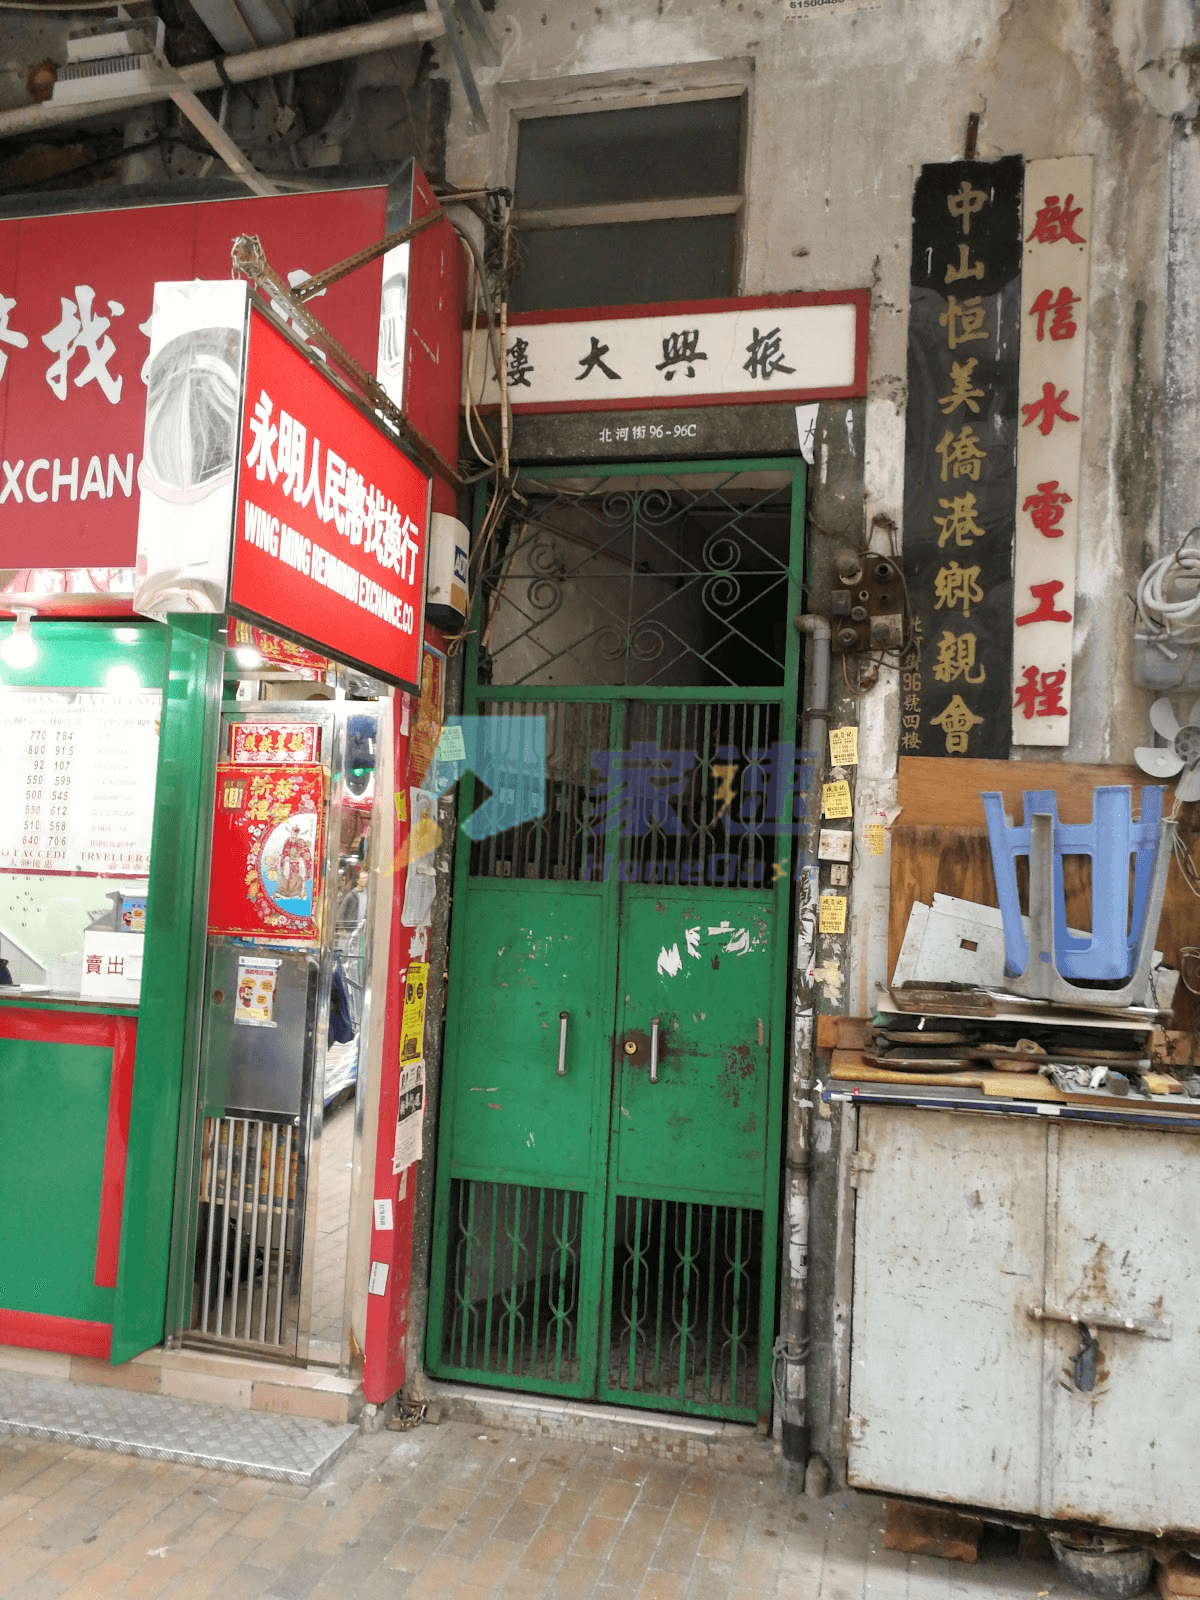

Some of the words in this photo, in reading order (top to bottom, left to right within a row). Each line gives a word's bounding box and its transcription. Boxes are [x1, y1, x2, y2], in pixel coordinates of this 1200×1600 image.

[930, 181, 990, 754] 中山恒美僑港鄉親會
[0, 452, 146, 505] XCHAN
[246, 390, 419, 586] 永明人民幣找換行
[244, 500, 280, 557] WING
[280, 523, 312, 577] MING
[312, 538, 360, 594] RENMINBI
[30, 730, 47, 740] 770
[56, 731, 73, 741] 784
[28, 745, 46, 755] 800
[55, 746, 74, 756] 915
[34, 760, 45, 770] 92
[54, 761, 70, 771] 107
[26, 775, 43, 785] 550
[54, 776, 71, 786] 599
[25, 790, 42, 799] 500
[51, 791, 68, 801] 545
[24, 805, 41, 815] 550
[50, 806, 67, 816] 612
[23, 820, 40, 830] 510
[49, 821, 66, 831] 568
[22, 835, 39, 845] 640
[48, 836, 66, 846] 706
[86, 954, 125, 975] 賣出
